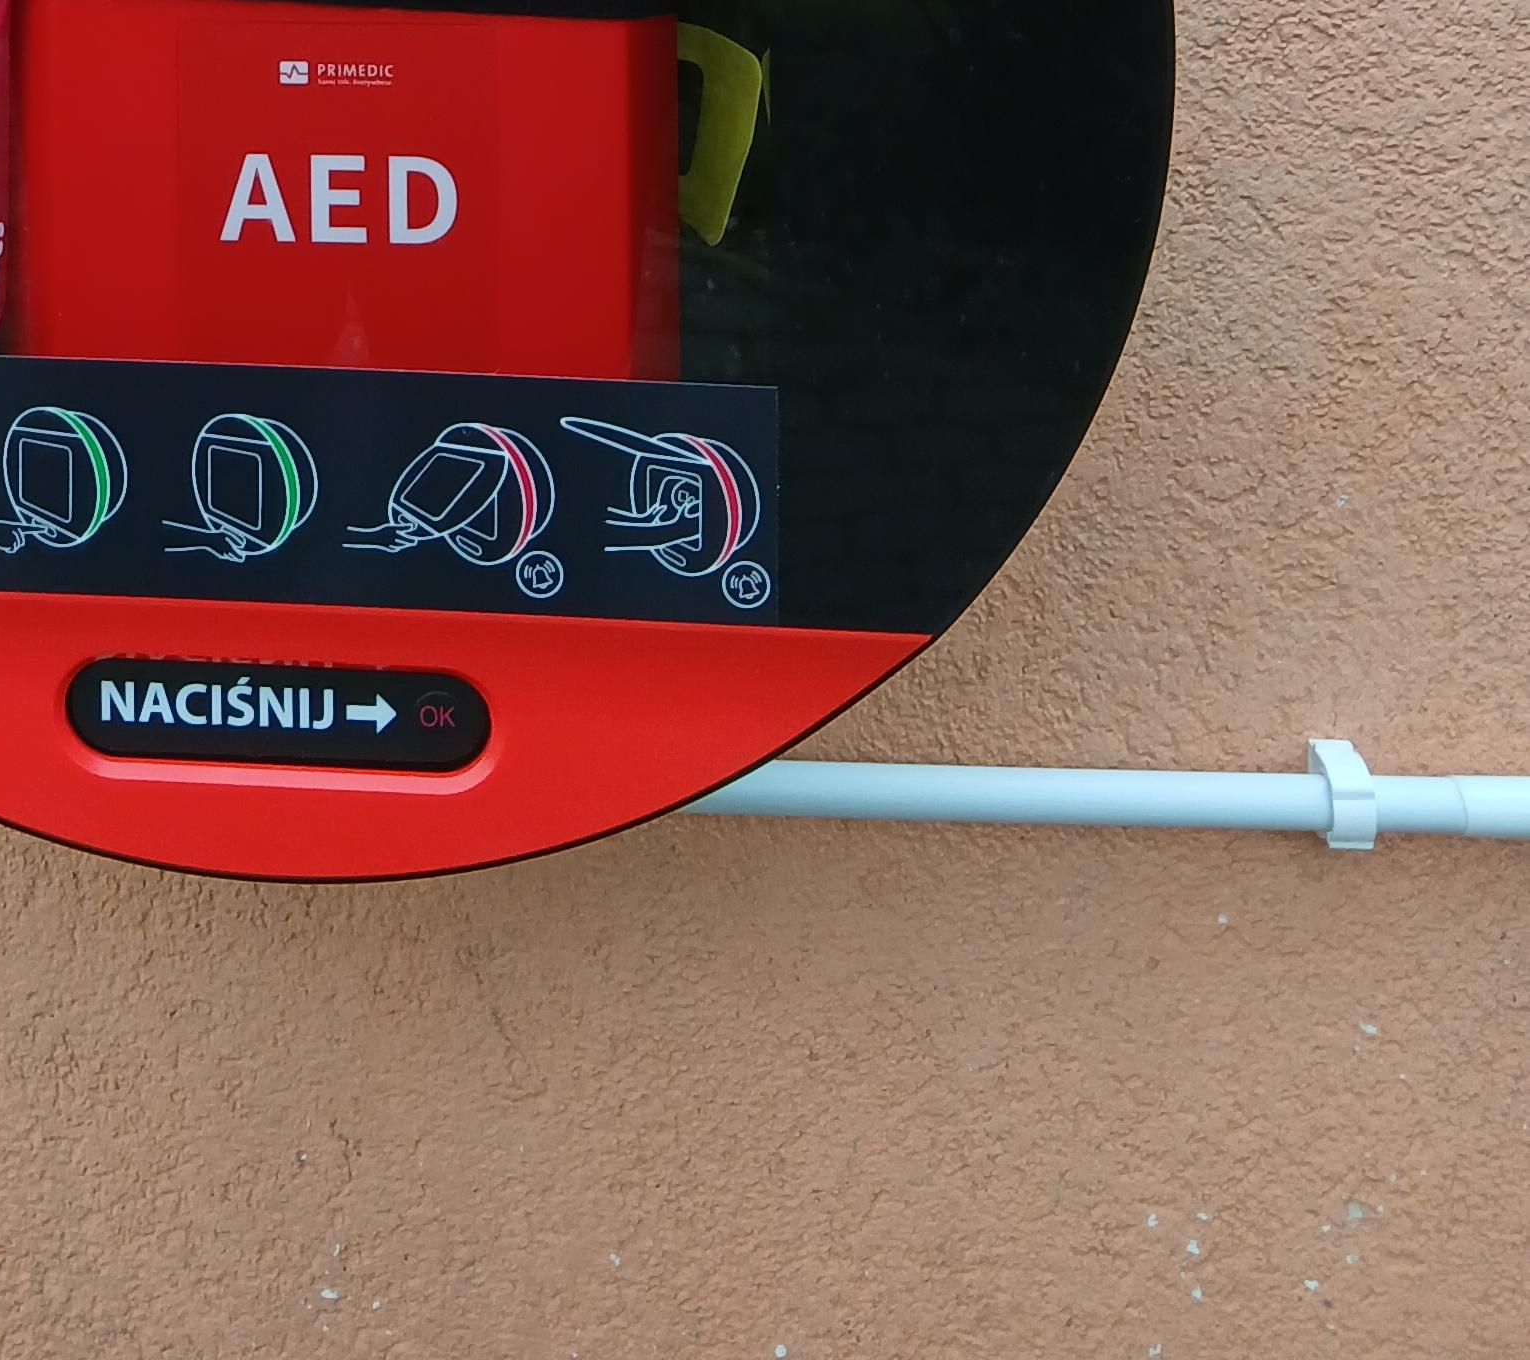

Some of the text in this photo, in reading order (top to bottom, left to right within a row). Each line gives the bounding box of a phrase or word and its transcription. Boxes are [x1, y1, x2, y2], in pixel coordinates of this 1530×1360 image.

[317, 63, 394, 78] PRIMEDIC
[219, 153, 458, 245] AED
[100, 676, 456, 730] NACIŚNIJ OK
